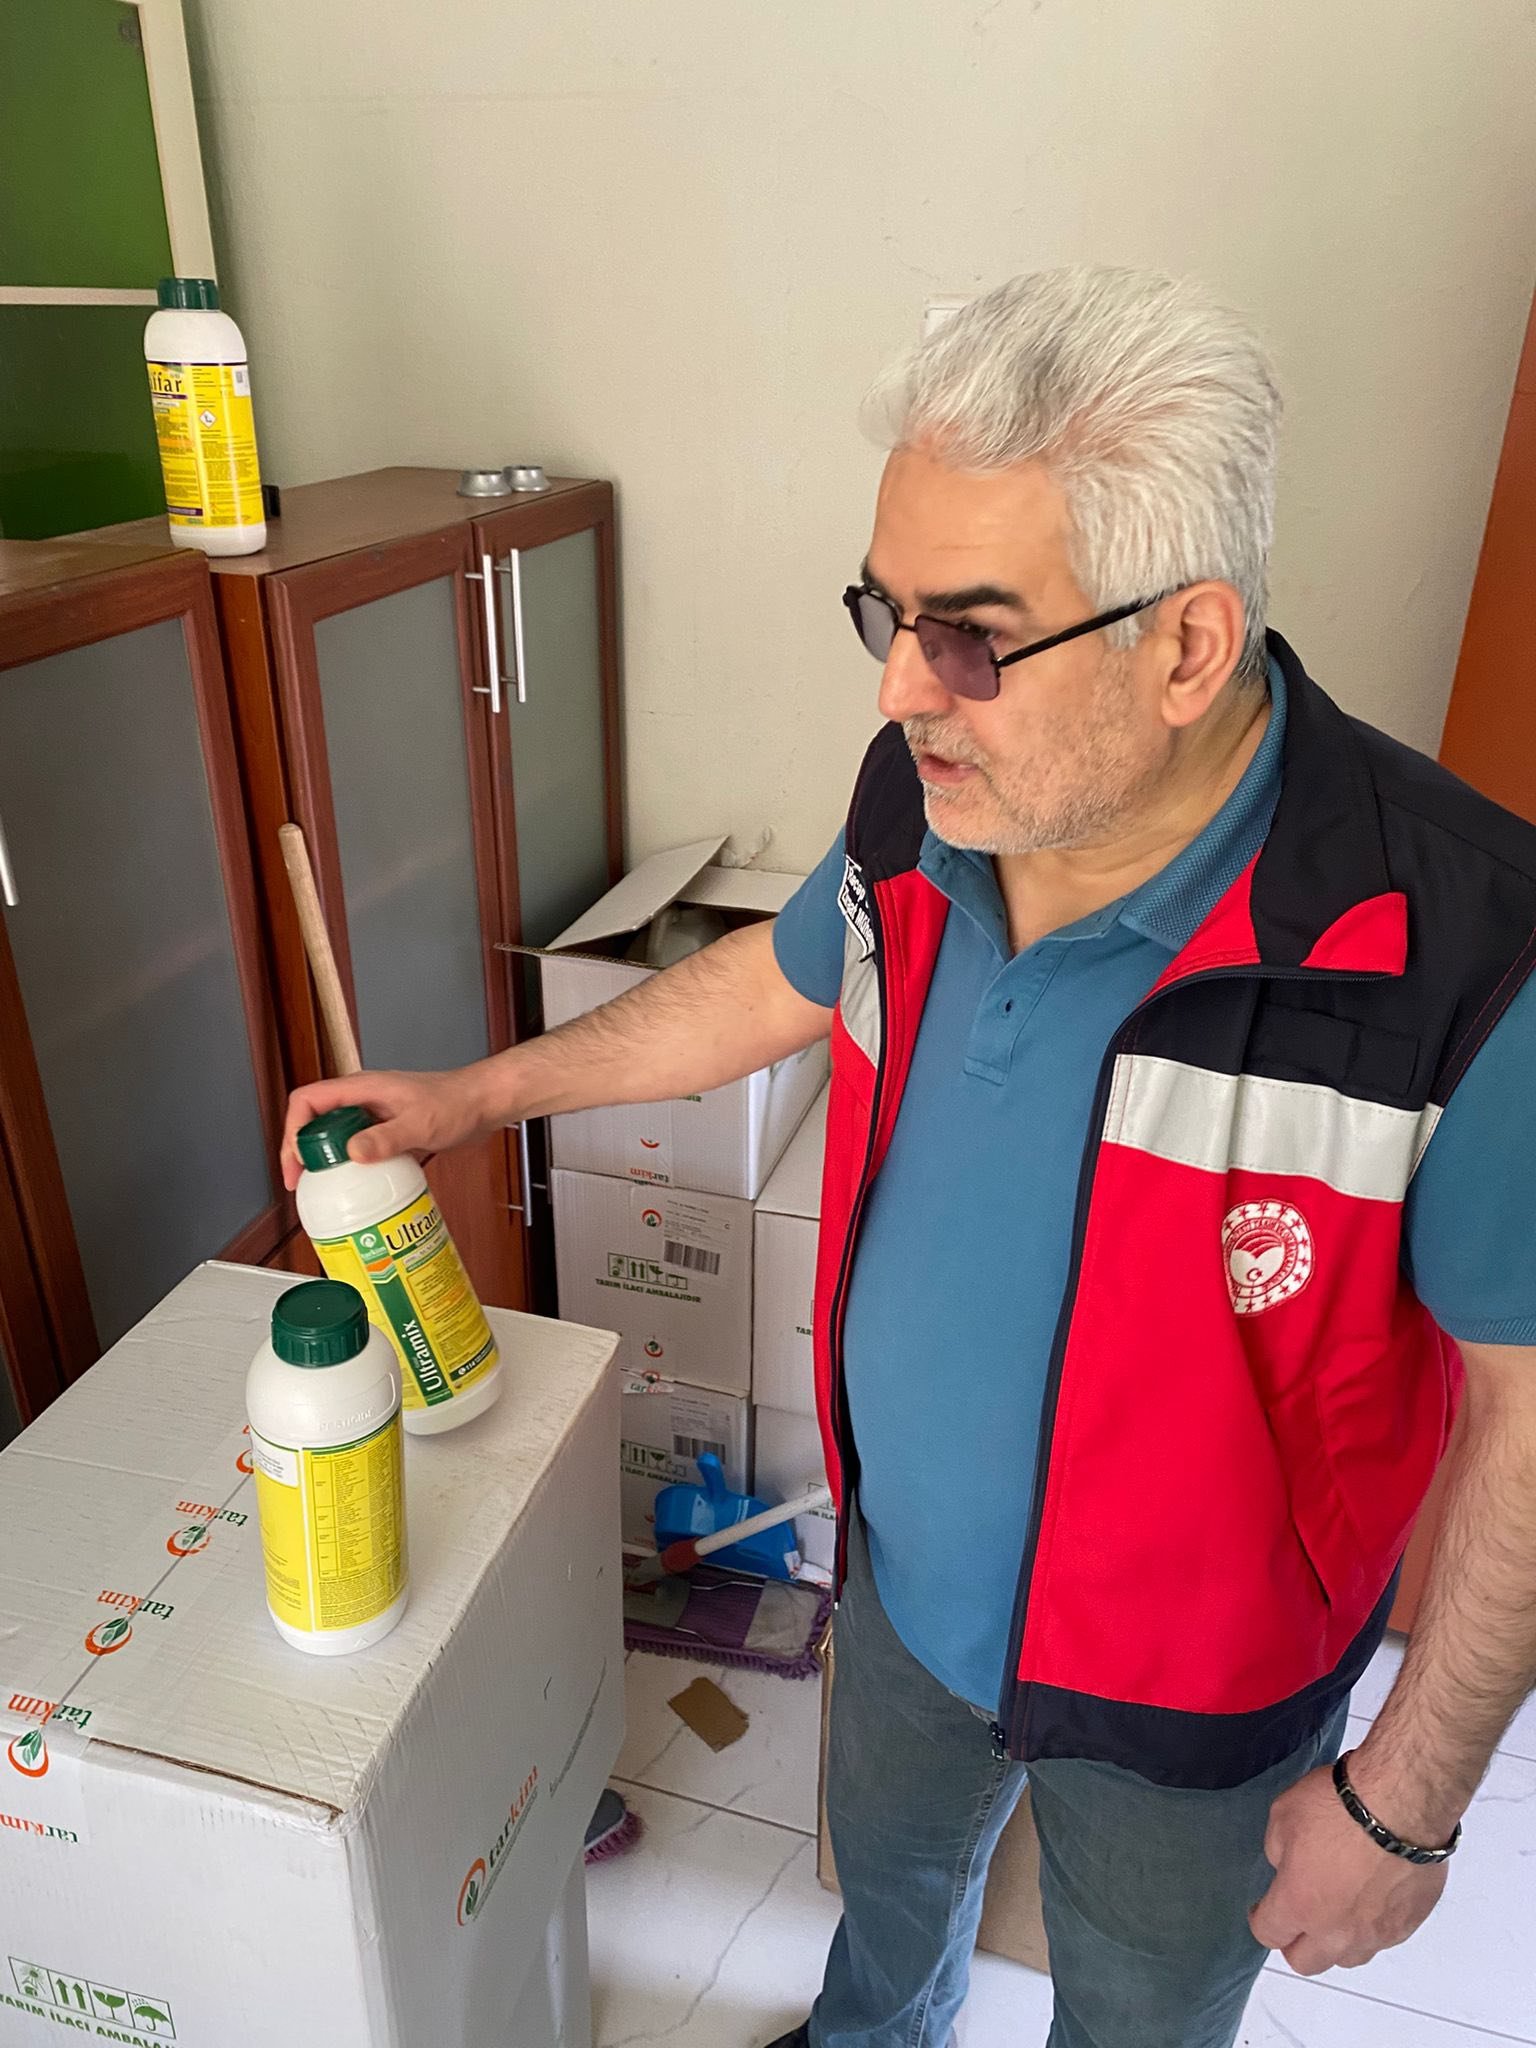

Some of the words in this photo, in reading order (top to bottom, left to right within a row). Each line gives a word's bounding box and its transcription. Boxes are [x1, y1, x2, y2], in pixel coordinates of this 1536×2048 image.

[385, 1205, 441, 1252] Ultram
[402, 1319, 442, 1393] Ultramix
[97, 1589, 175, 1621] tarkim
[8, 1693, 93, 1730] tarkim
[487, 1765, 538, 1868] tarkim
[50, 2010, 91, 2033] İLACI
